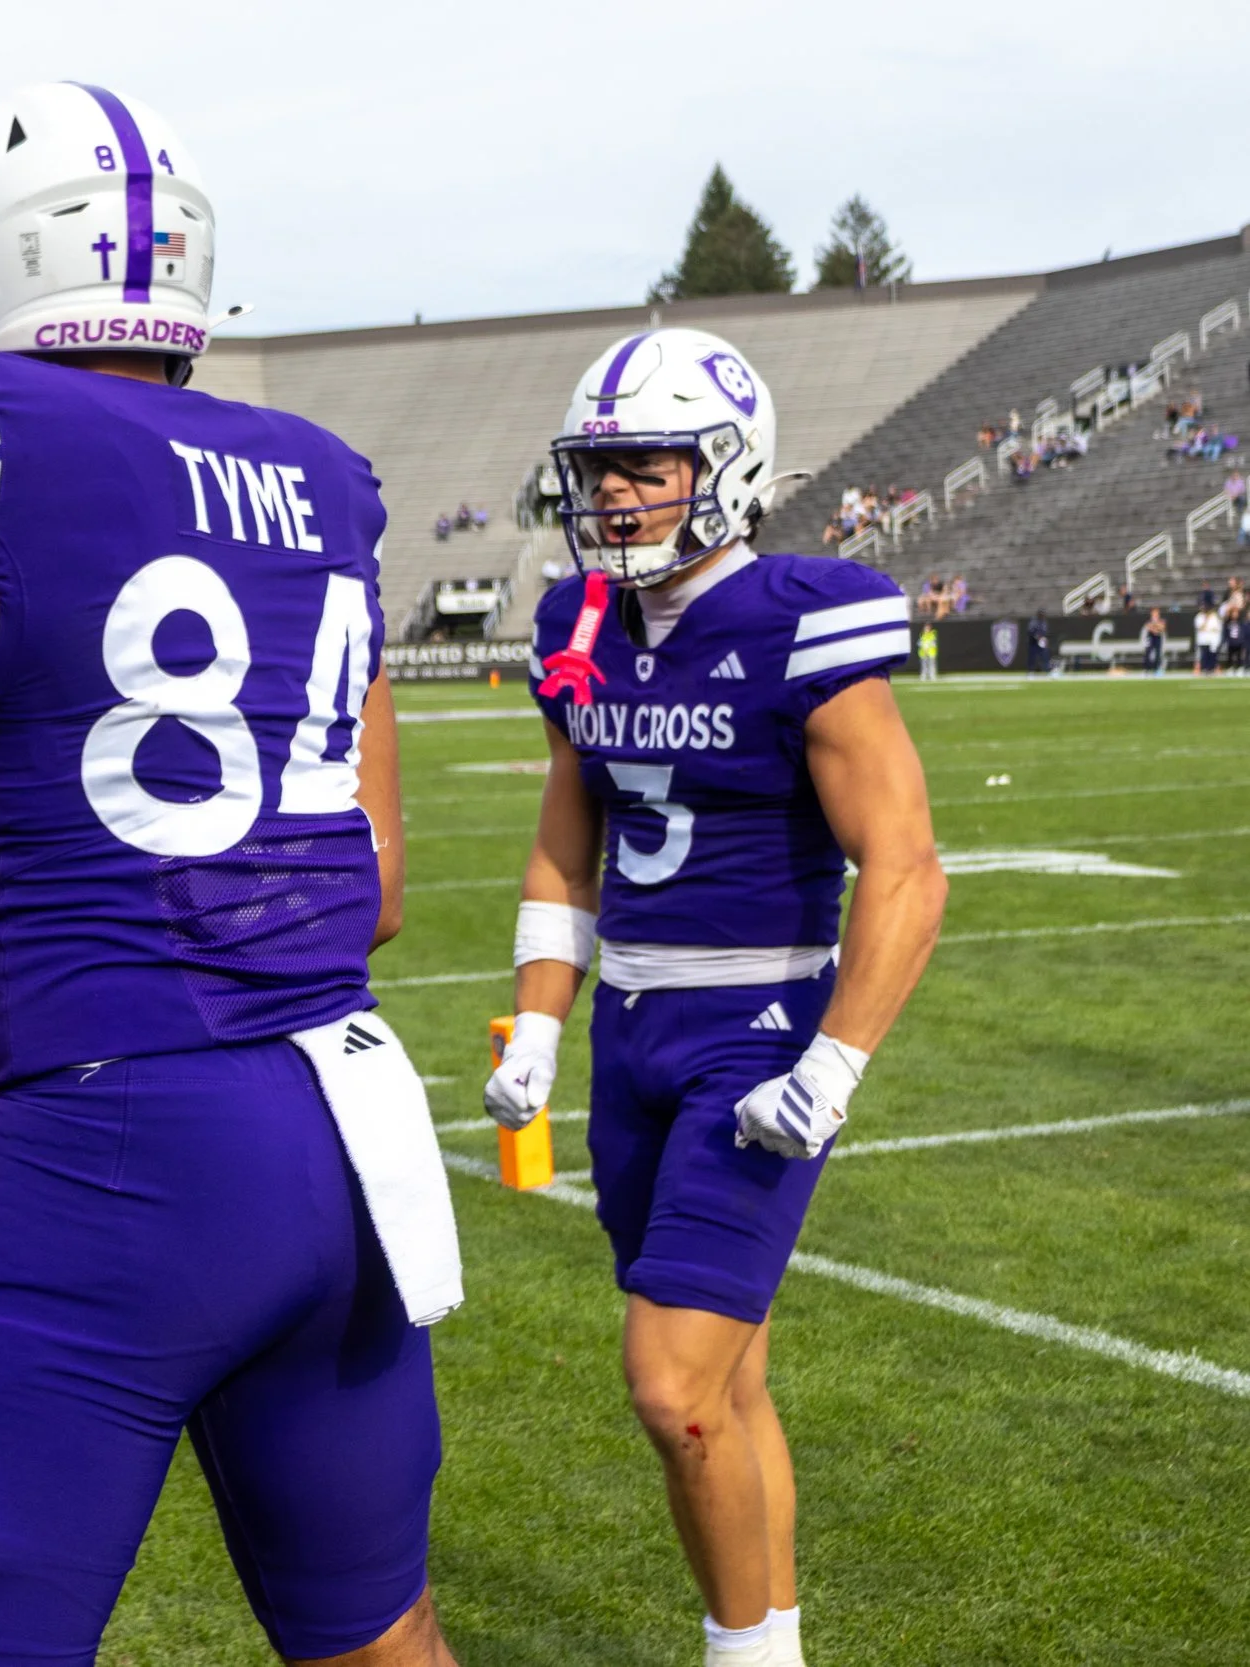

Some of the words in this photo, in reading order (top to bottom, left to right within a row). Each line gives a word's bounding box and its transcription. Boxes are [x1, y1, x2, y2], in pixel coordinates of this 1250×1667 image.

[94, 145, 116, 172] 8
[156, 148, 174, 176] 4
[35, 318, 206, 351] CRUSADERS
[581, 420, 619, 434] 508
[169, 439, 324, 553] TYME
[81, 555, 372, 857] 84
[565, 702, 628, 747] HOLY
[633, 703, 735, 750] CROSS
[605, 760, 695, 886] 3
